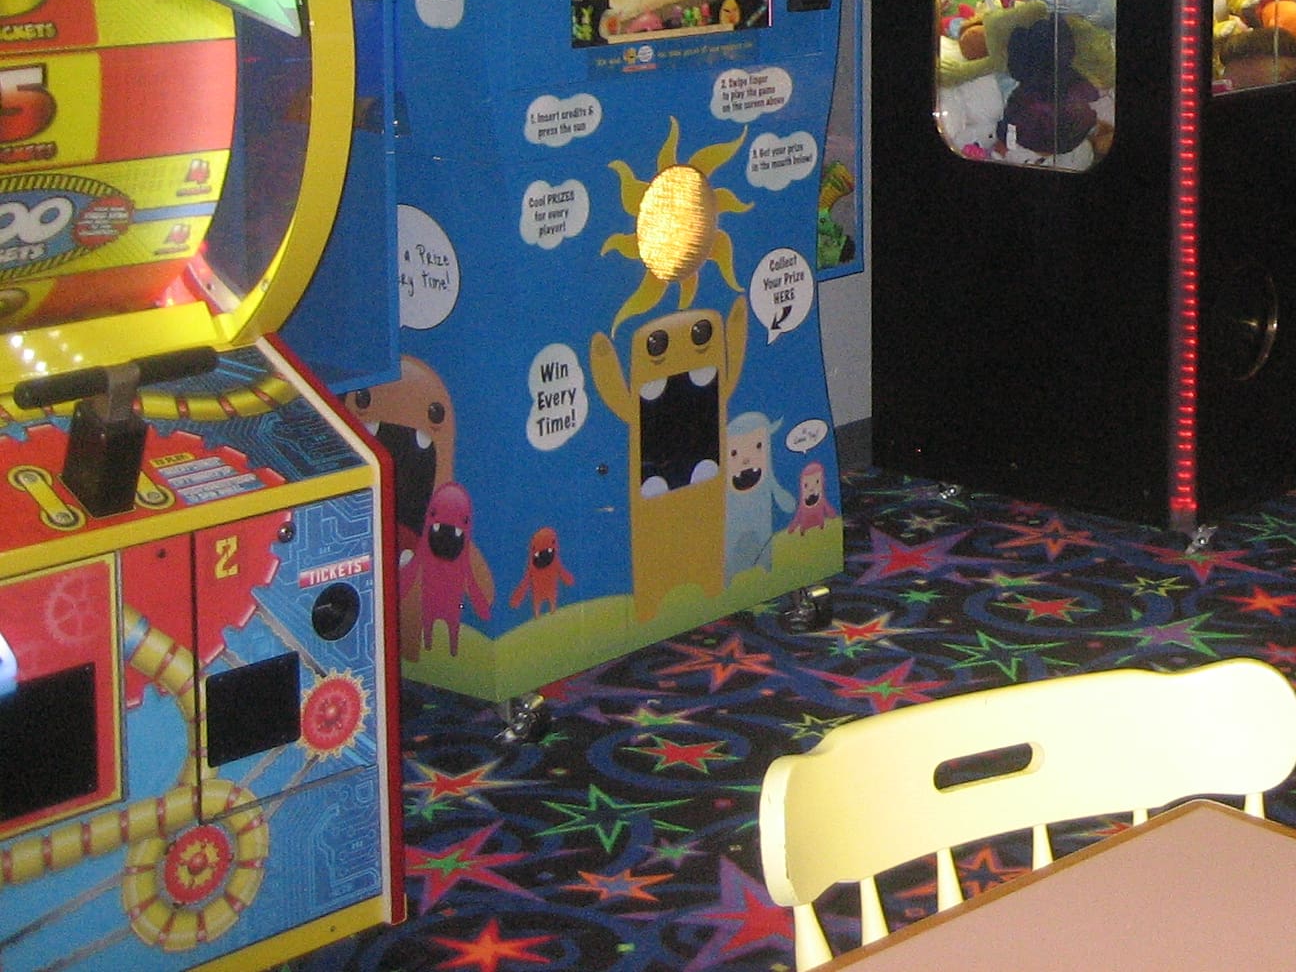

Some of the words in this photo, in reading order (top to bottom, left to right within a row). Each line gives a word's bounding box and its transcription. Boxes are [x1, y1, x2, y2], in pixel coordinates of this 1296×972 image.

[529, 194, 546, 208] Cool
[547, 190, 575, 204] PRIZES
[535, 210, 546, 221] for
[547, 209, 568, 220] every
[769, 254, 797, 273] Collect
[763, 277, 781, 291] Your
[783, 271, 805, 286] Prize
[773, 288, 796, 305] HERE
[541, 362, 569, 383] Win
[537, 388, 576, 411] Every
[536, 409, 576, 437] Time!
[215, 535, 239, 579] 2
[309, 560, 363, 585] TICKETS
